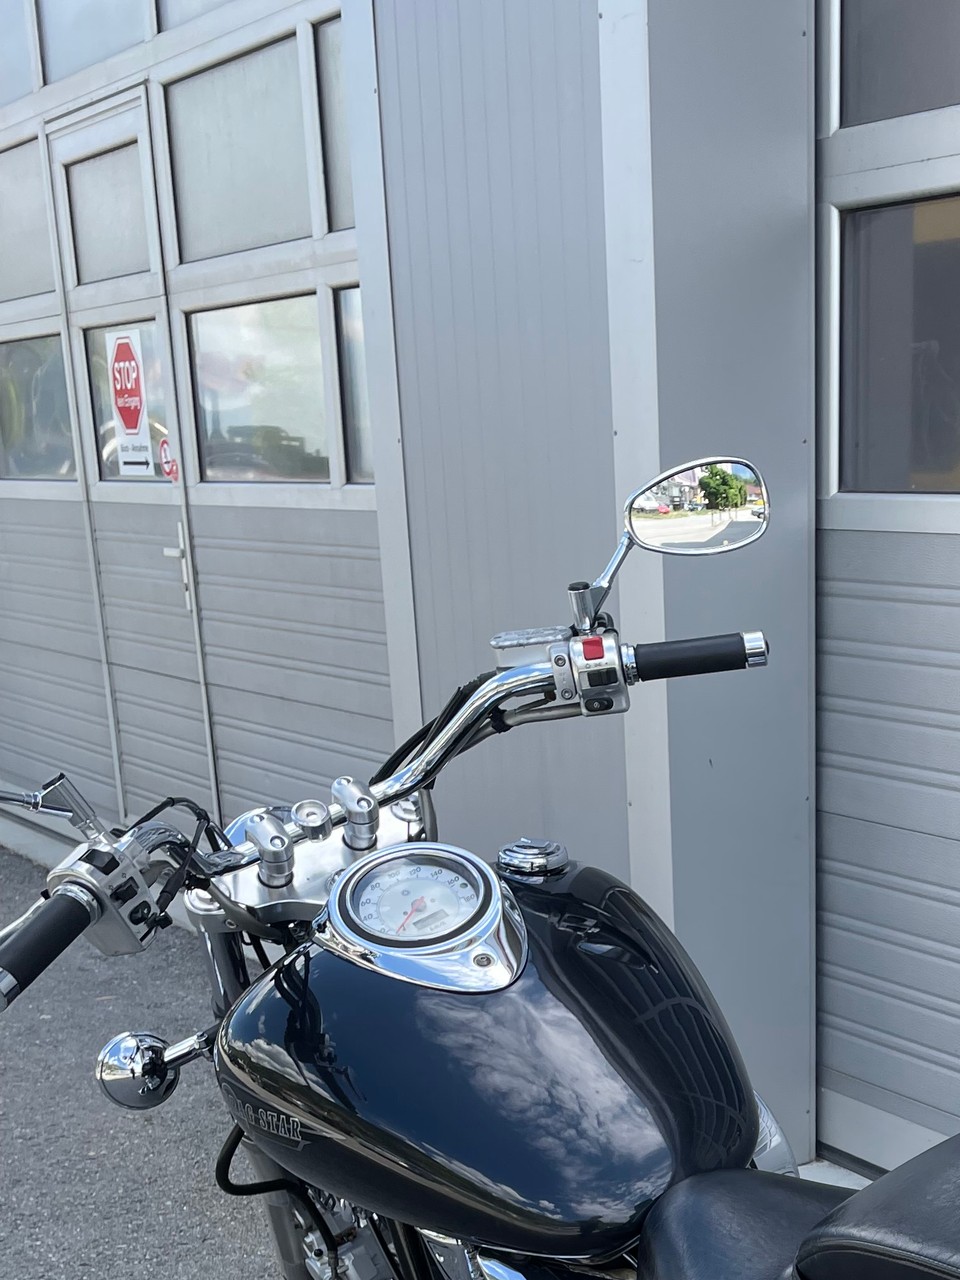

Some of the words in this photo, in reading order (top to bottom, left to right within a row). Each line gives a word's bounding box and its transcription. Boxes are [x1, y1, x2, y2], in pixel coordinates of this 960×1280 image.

[114, 360, 137, 390] STOP
[409, 866, 421, 875] 120
[430, 869, 443, 878] 140
[447, 876, 460, 885] 160
[370, 882, 380, 891] 80
[360, 898, 371, 906] 60
[363, 913, 373, 921] 40
[258, 1109, 302, 1140] STAR
